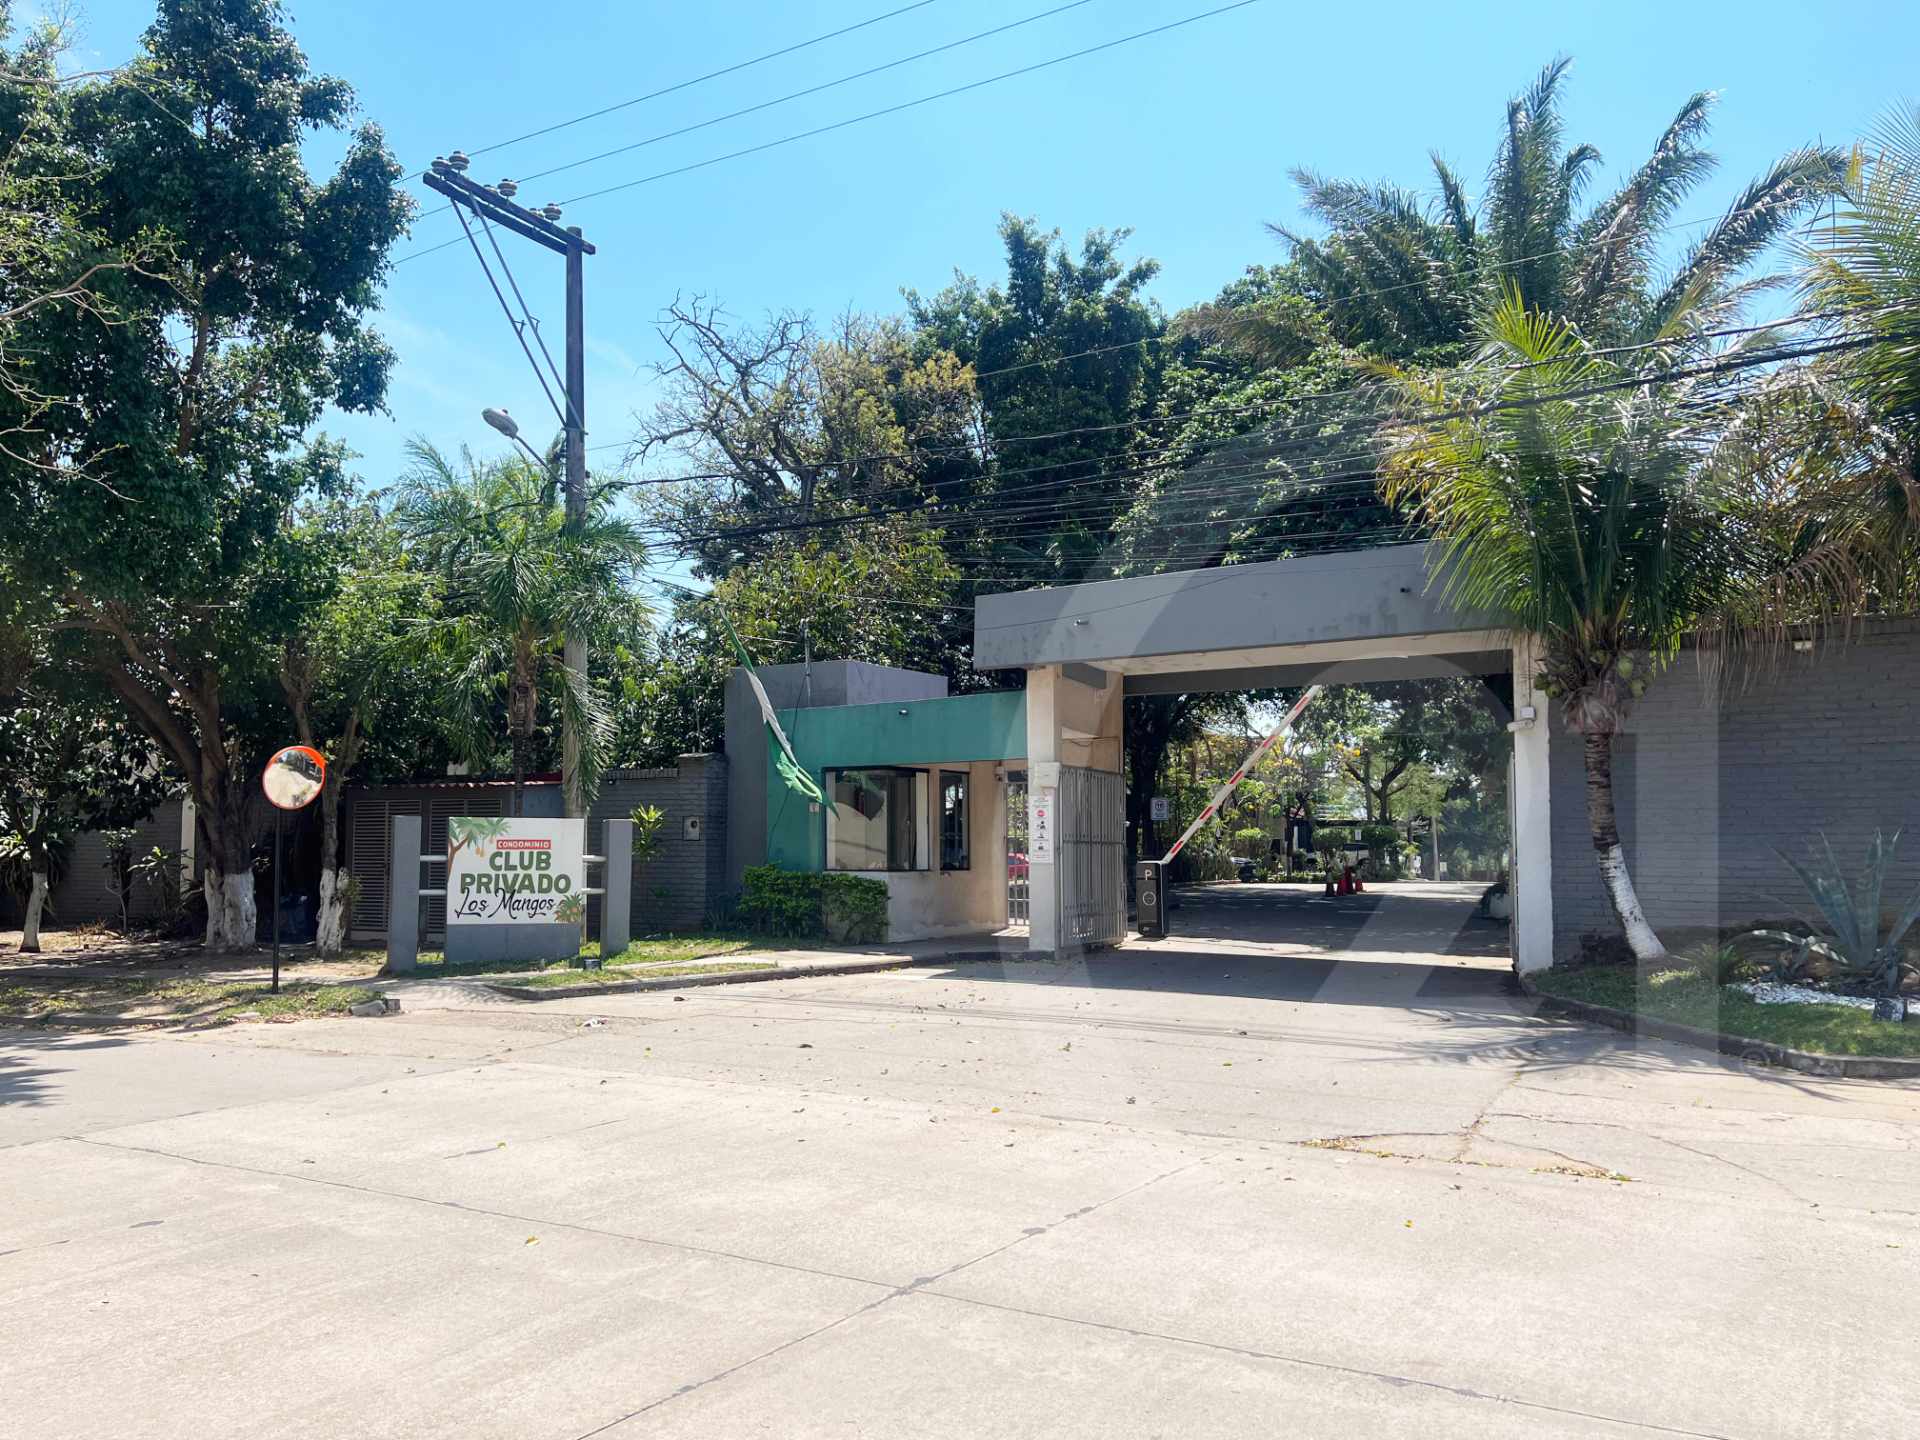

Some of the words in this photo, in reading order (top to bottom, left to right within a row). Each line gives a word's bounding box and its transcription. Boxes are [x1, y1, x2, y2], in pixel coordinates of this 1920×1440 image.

[498, 840, 549, 848] CONDOMINIO
[489, 851, 552, 871] CLUB
[460, 873, 571, 894] PRIVADO
[455, 887, 489, 919] Los
[488, 888, 555, 920] Mangos
